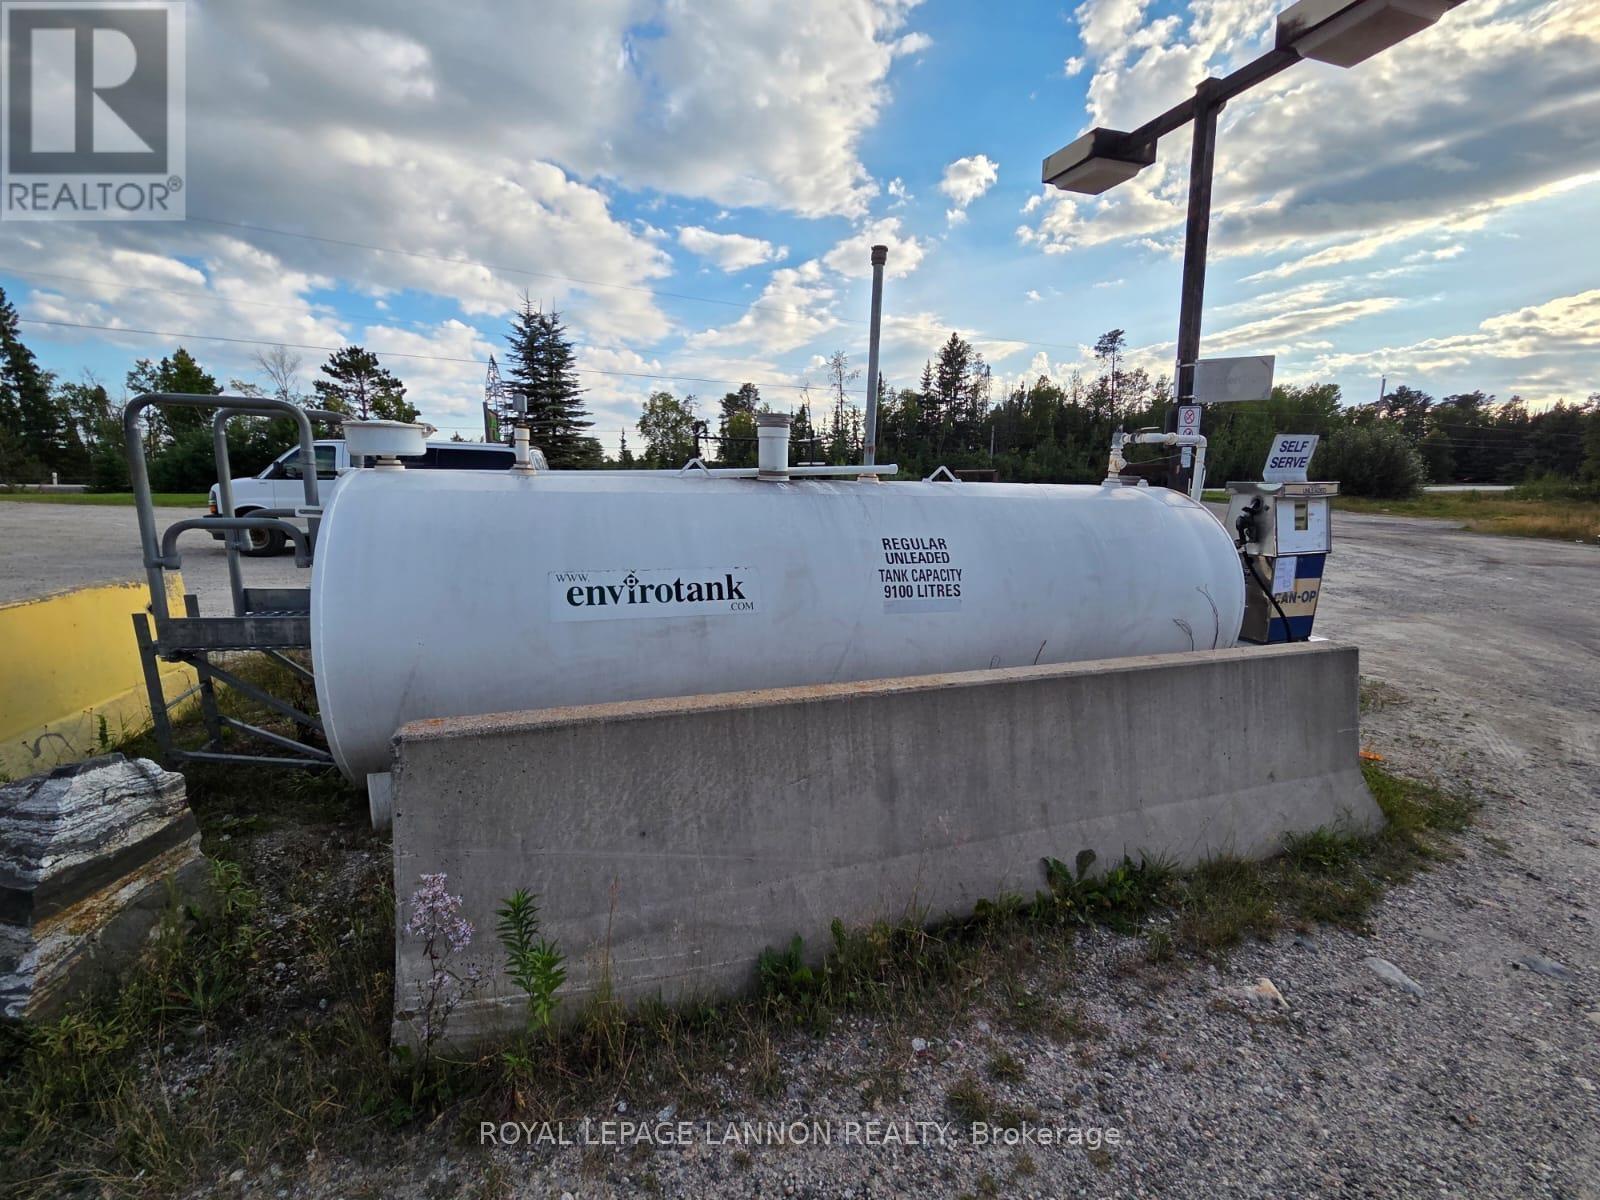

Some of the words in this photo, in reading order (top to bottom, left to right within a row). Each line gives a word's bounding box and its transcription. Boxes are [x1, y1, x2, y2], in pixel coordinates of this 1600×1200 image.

[1279, 440, 1309, 453] SELF
[1270, 456, 1308, 469] SERVE
[881, 537, 948, 551] REGULAR
[885, 551, 950, 565] UNLEADED
[878, 568, 909, 582] TANK
[911, 568, 962, 582] CAPACITY
[566, 573, 746, 607] envirotank
[884, 584, 914, 598] 9100
[917, 583, 961, 598] LITRES
[1274, 590, 1317, 604] CAN-OP
